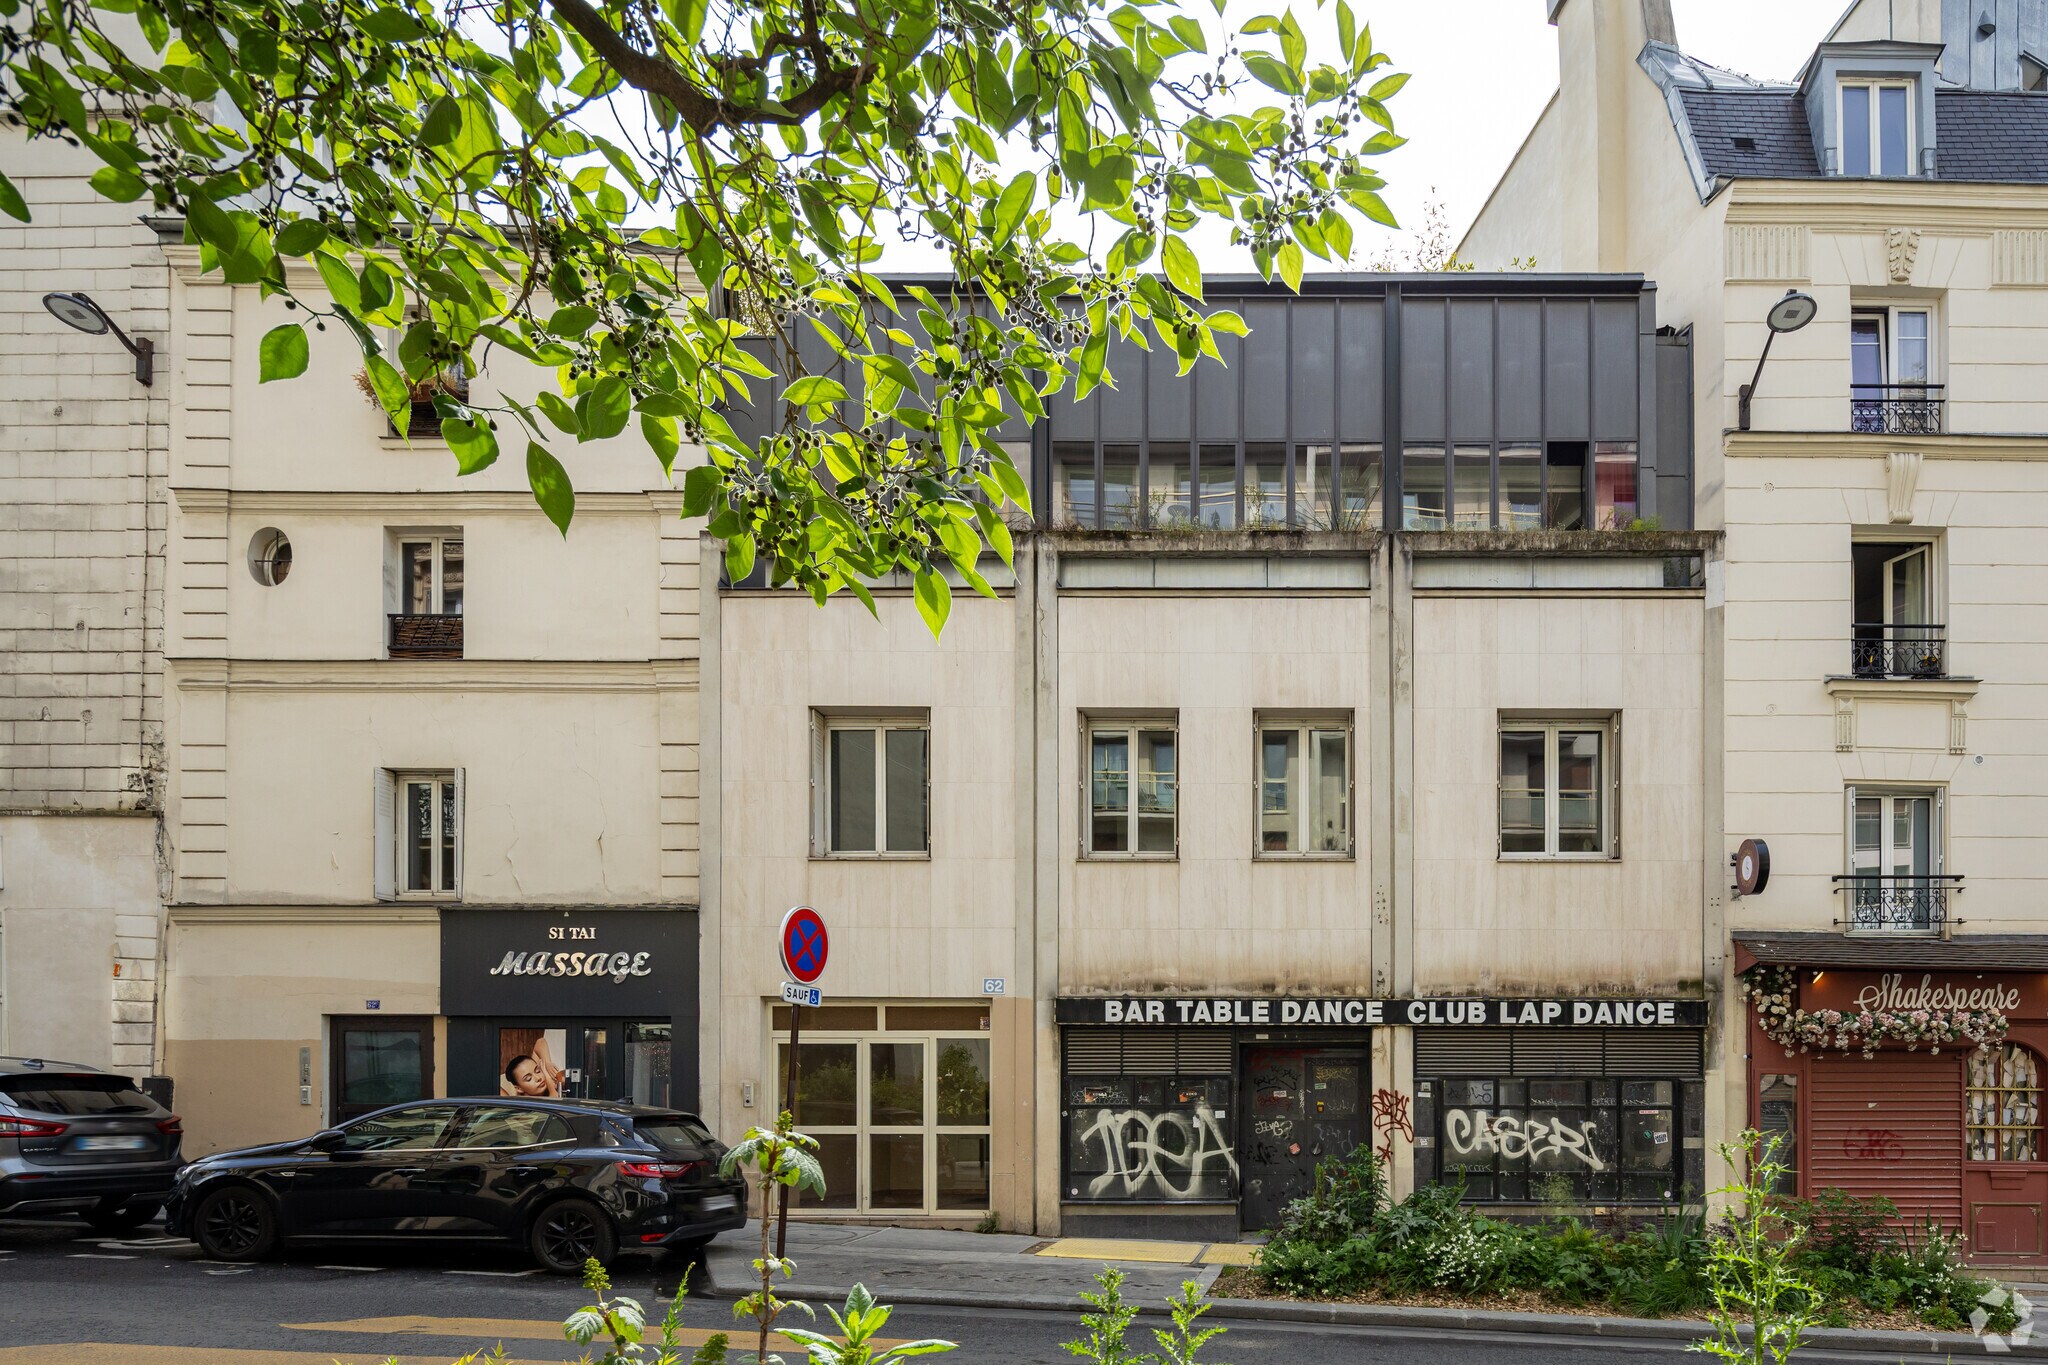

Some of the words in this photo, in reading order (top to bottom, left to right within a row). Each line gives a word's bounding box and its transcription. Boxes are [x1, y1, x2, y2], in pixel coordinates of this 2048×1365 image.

[549, 927, 564, 940] SI
[569, 927, 597, 940] TAI
[985, 980, 1003, 992] 62
[1852, 973, 2021, 1013] Shakespeare
[786, 987, 809, 1001] SAUF
[1104, 1000, 1165, 1023] BAR
[1176, 1000, 1270, 1023] TABLE
[1281, 1000, 1384, 1023] DANCE
[1407, 1001, 1487, 1024] CLUB
[1499, 1001, 1562, 1024] LAP
[1573, 1001, 1675, 1024] DANCE
